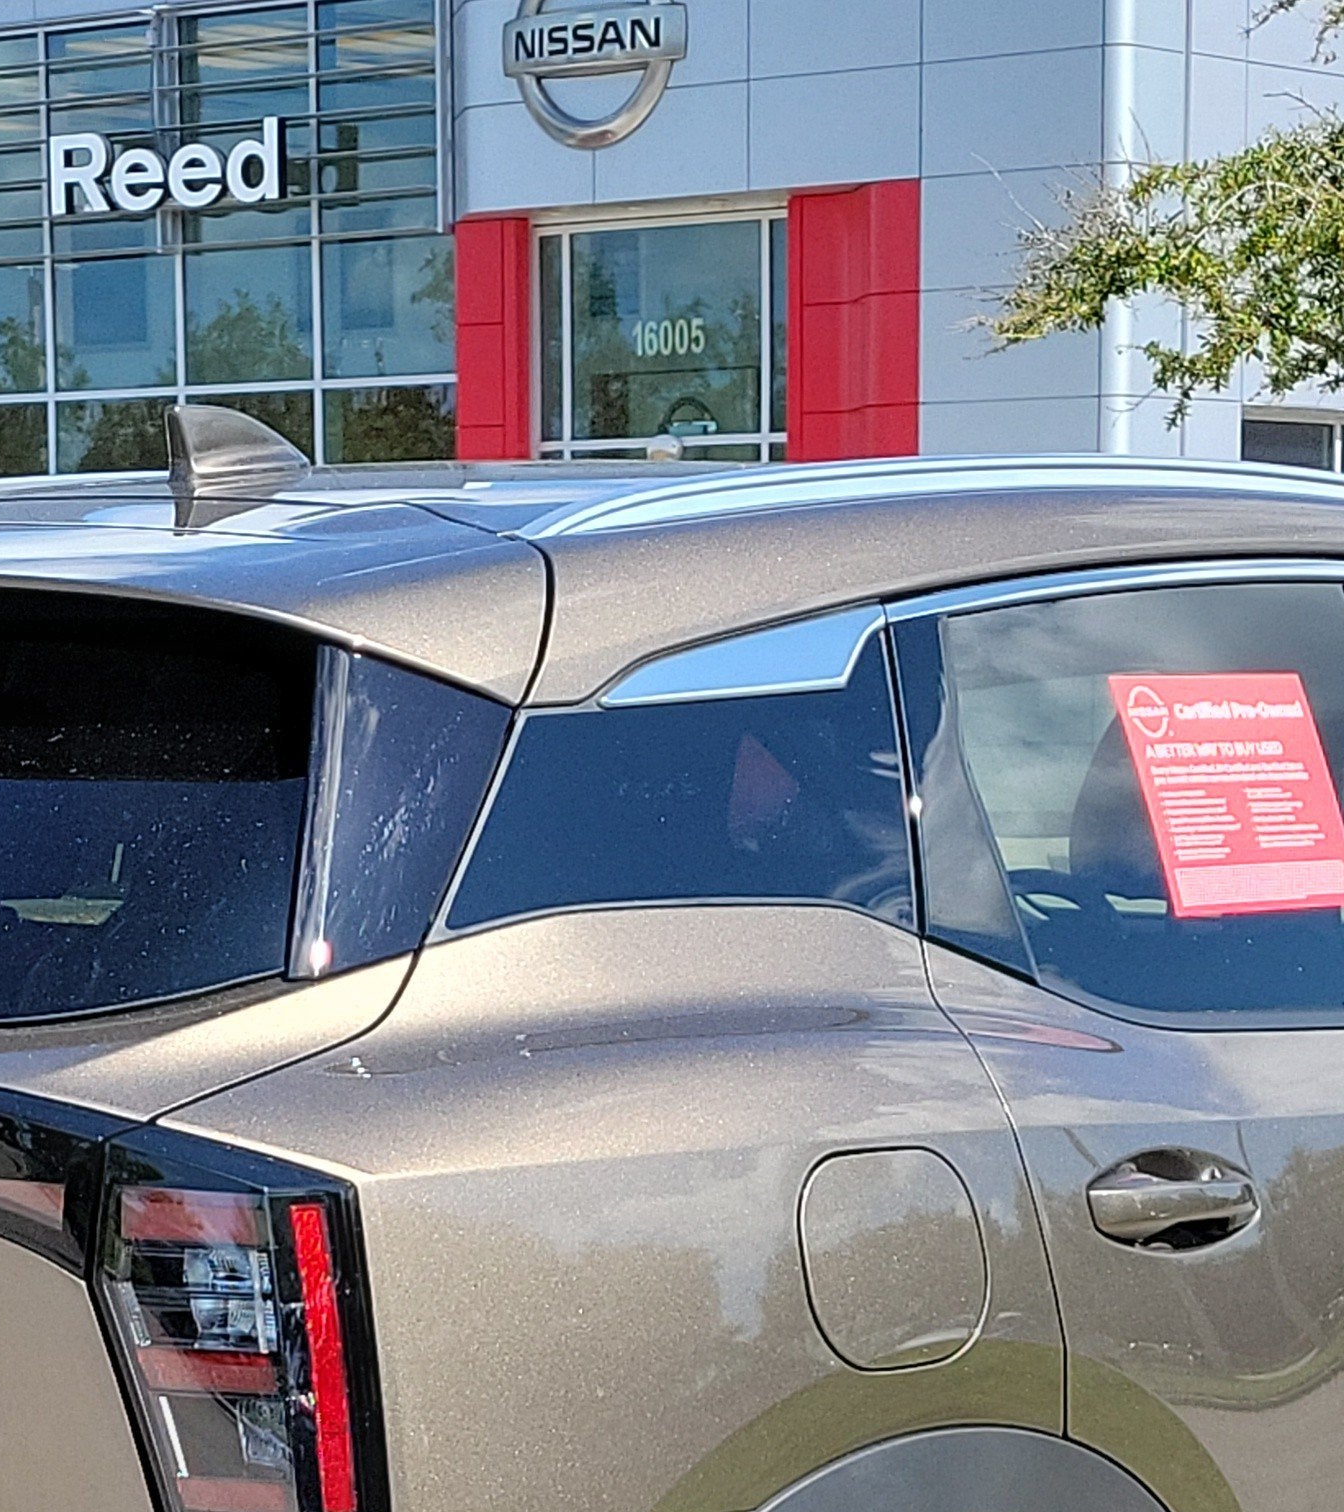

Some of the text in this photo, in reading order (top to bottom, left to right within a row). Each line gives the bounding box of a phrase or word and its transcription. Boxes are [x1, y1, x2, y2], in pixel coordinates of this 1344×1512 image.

[515, 16, 661, 62] NISSAN
[49, 116, 284, 216] Reed
[632, 317, 705, 357] 16005
